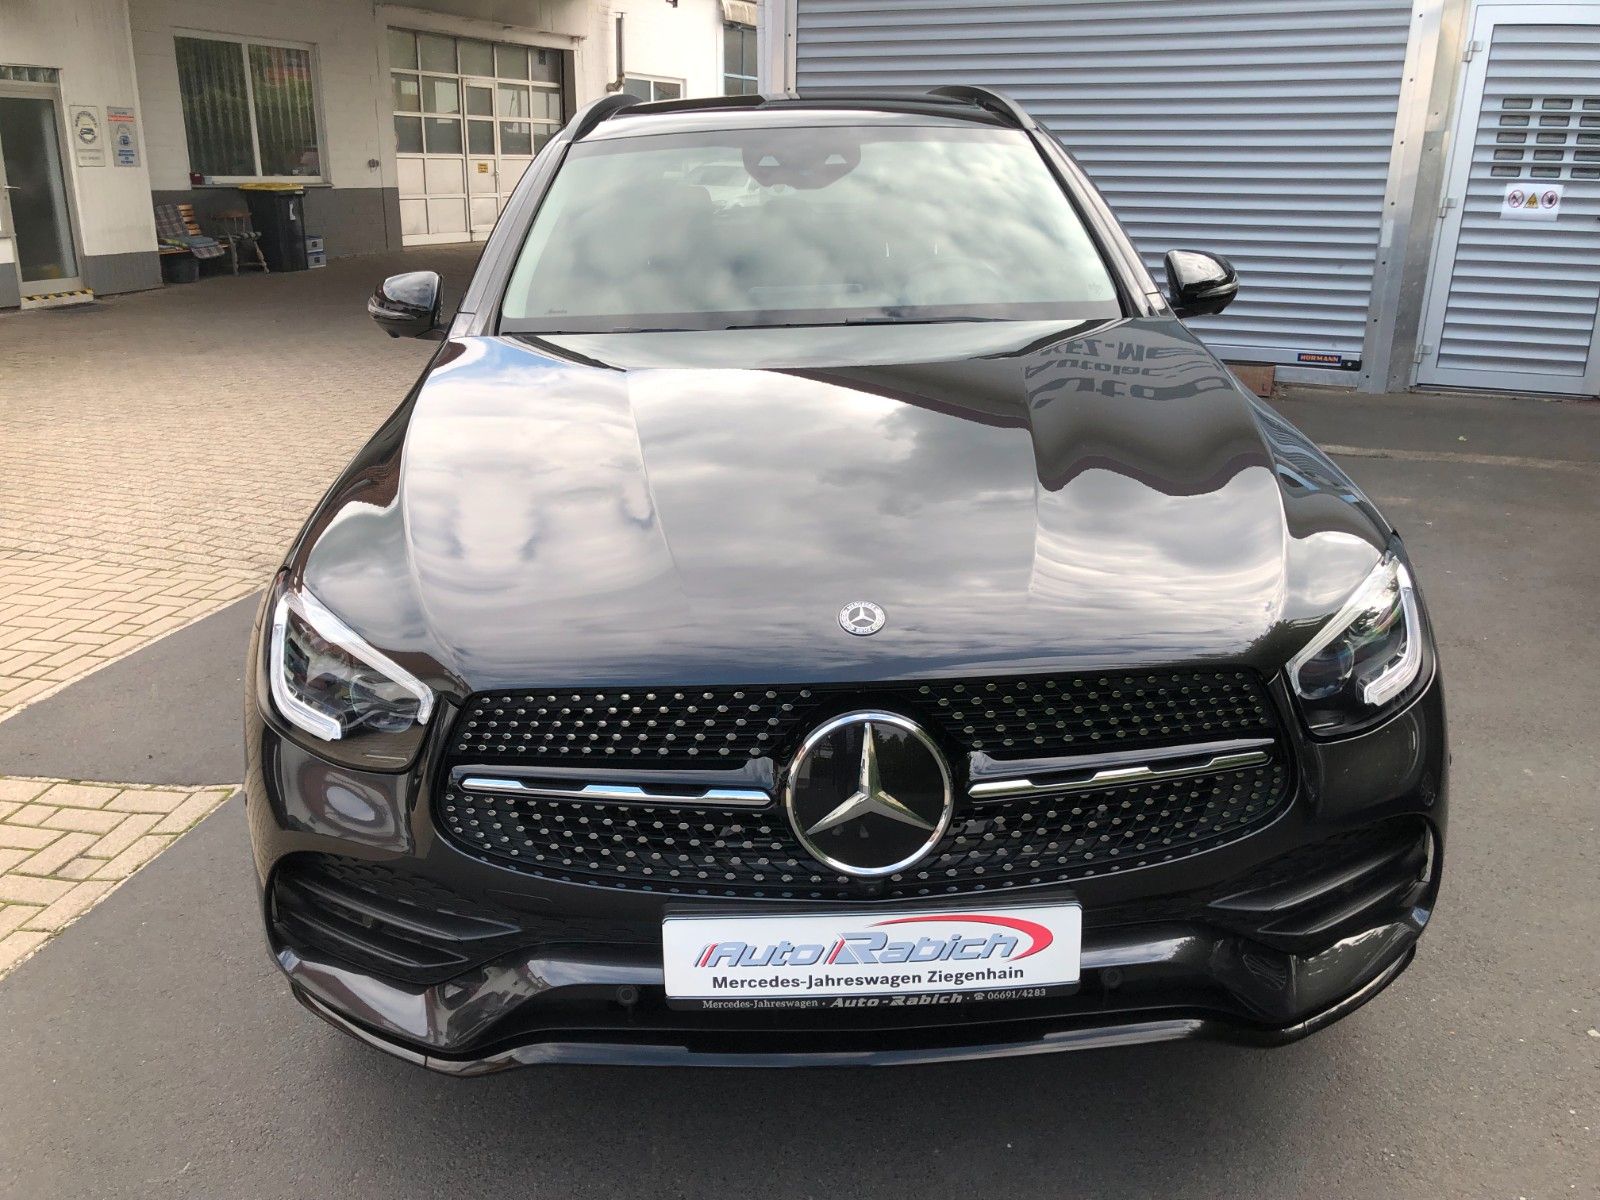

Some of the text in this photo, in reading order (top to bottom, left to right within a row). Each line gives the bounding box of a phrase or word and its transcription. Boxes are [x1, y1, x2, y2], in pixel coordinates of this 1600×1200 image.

[706, 931, 1019, 968] Auto Rabich
[712, 966, 1025, 990] Mercedes-Jahreswagen Ziegenhain
[702, 999, 818, 1011] Mercedes-Jahreswagen
[987, 988, 1046, 1000] 06691/4283
